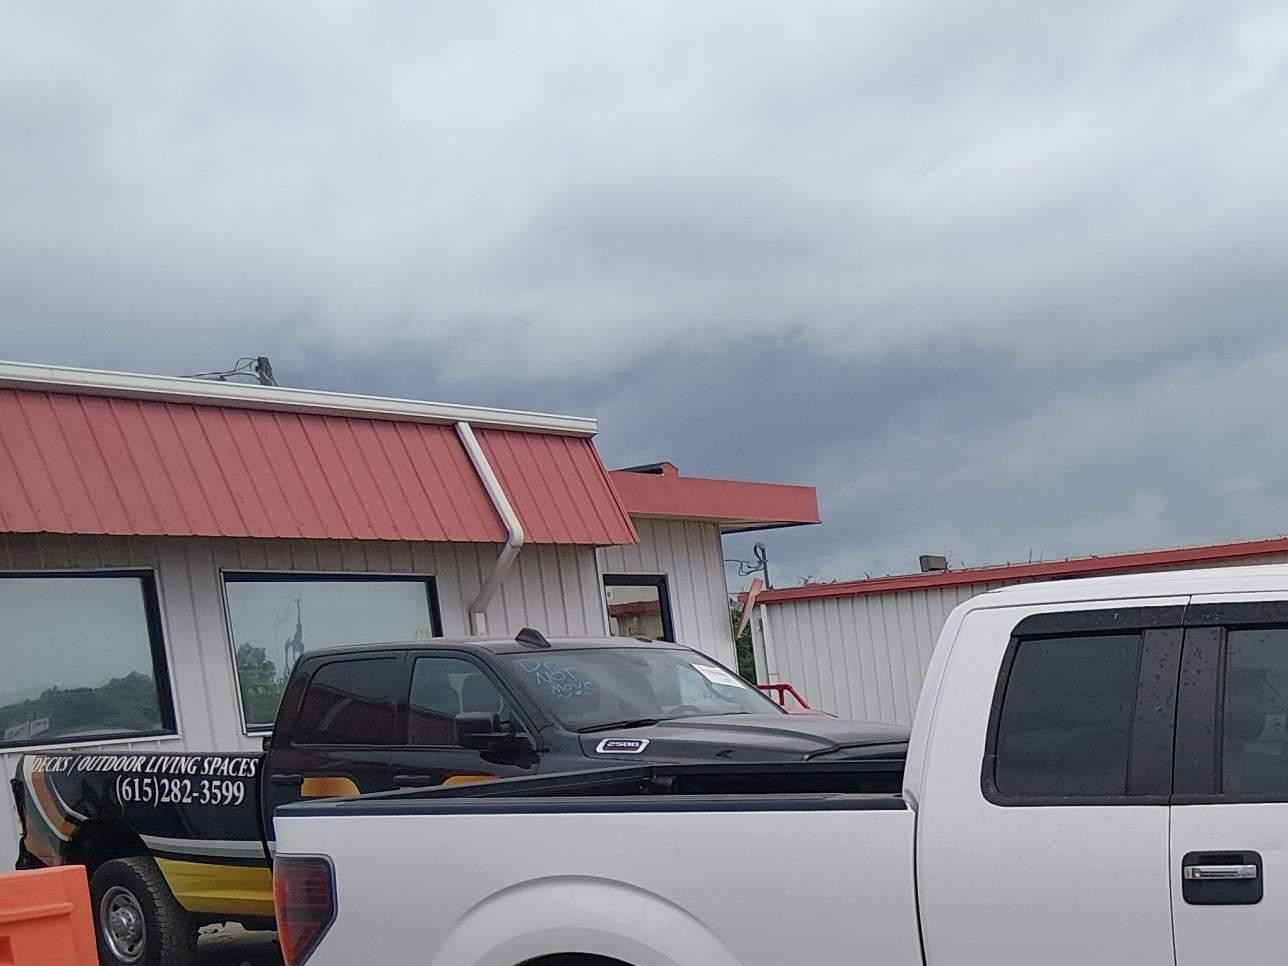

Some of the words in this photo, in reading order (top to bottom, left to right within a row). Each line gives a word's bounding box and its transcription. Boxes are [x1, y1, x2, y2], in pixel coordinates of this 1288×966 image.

[535, 667, 577, 684] NOT
[32, 755, 72, 772] DECKS
[79, 756, 147, 773] OUTDOOR
[145, 756, 201, 775] LIVING
[200, 757, 259, 777] SPACES
[115, 775, 245, 807] (615)282-3599
